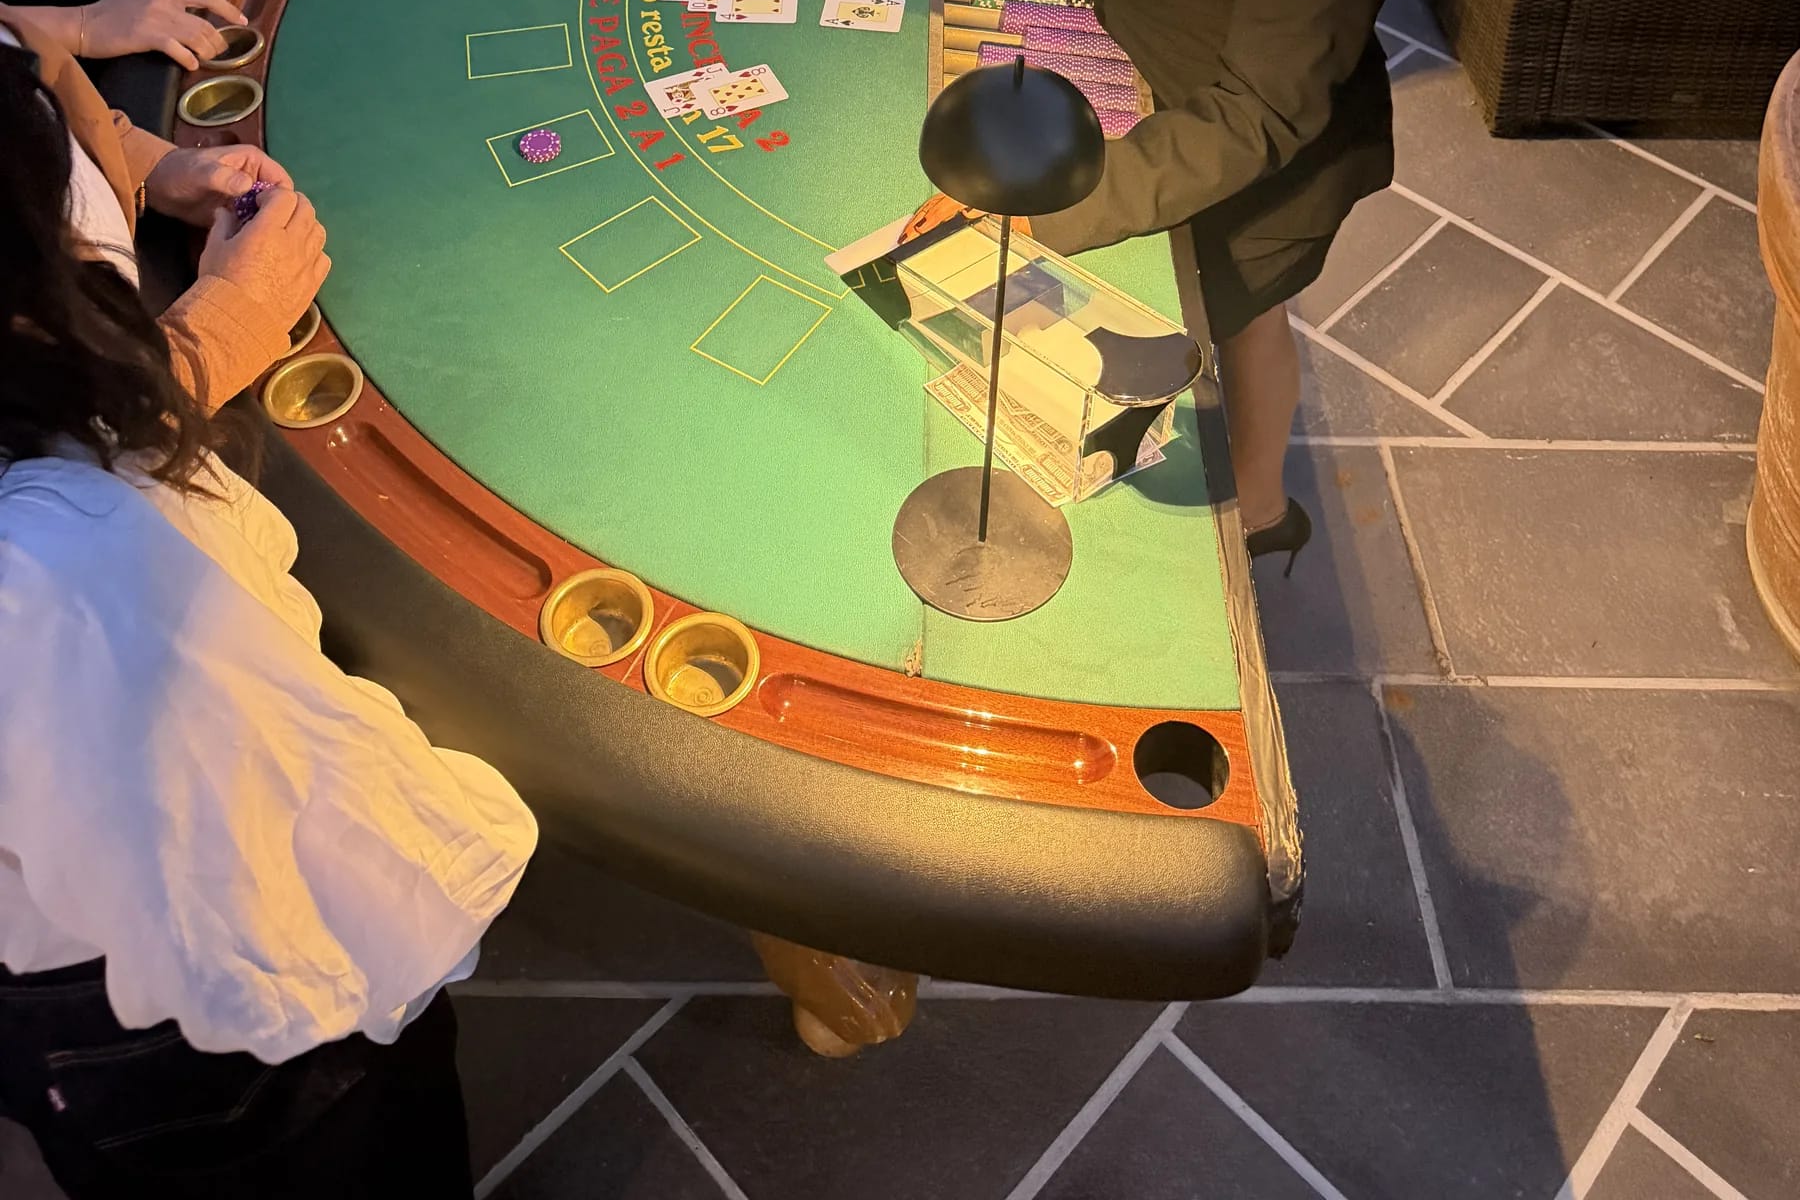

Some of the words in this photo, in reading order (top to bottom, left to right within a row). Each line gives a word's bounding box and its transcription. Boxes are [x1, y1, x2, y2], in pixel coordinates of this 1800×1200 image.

[588, 15, 635, 97] PAGA
[640, 9, 674, 74] resta
[696, 125, 744, 153] 17
[613, 100, 649, 120] 2
[628, 130, 666, 152] A
[754, 130, 791, 153] 2
